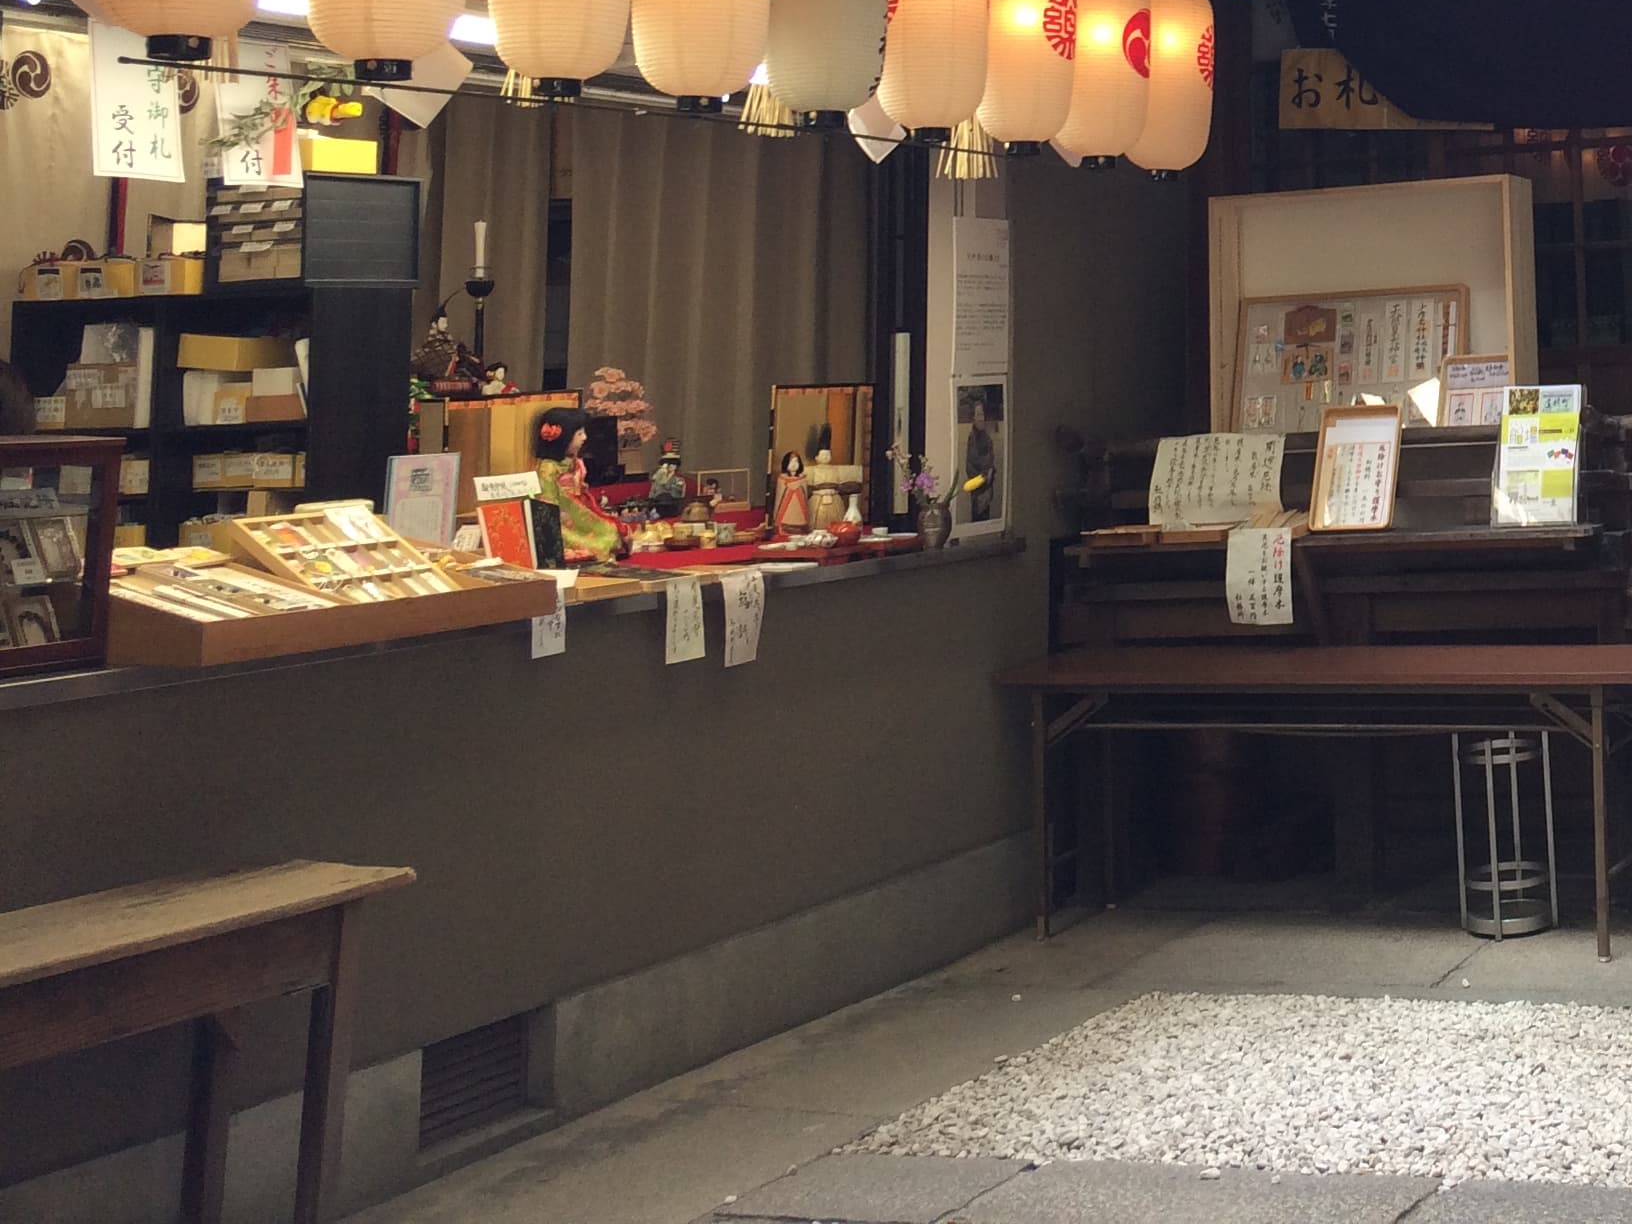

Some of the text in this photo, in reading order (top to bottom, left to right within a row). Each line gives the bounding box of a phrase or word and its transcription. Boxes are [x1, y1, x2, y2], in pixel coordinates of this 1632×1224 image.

[1292, 65, 1378, 110] お札
[112, 105, 137, 168] 受付
[1273, 534, 1285, 610] 厄除け護摩木
